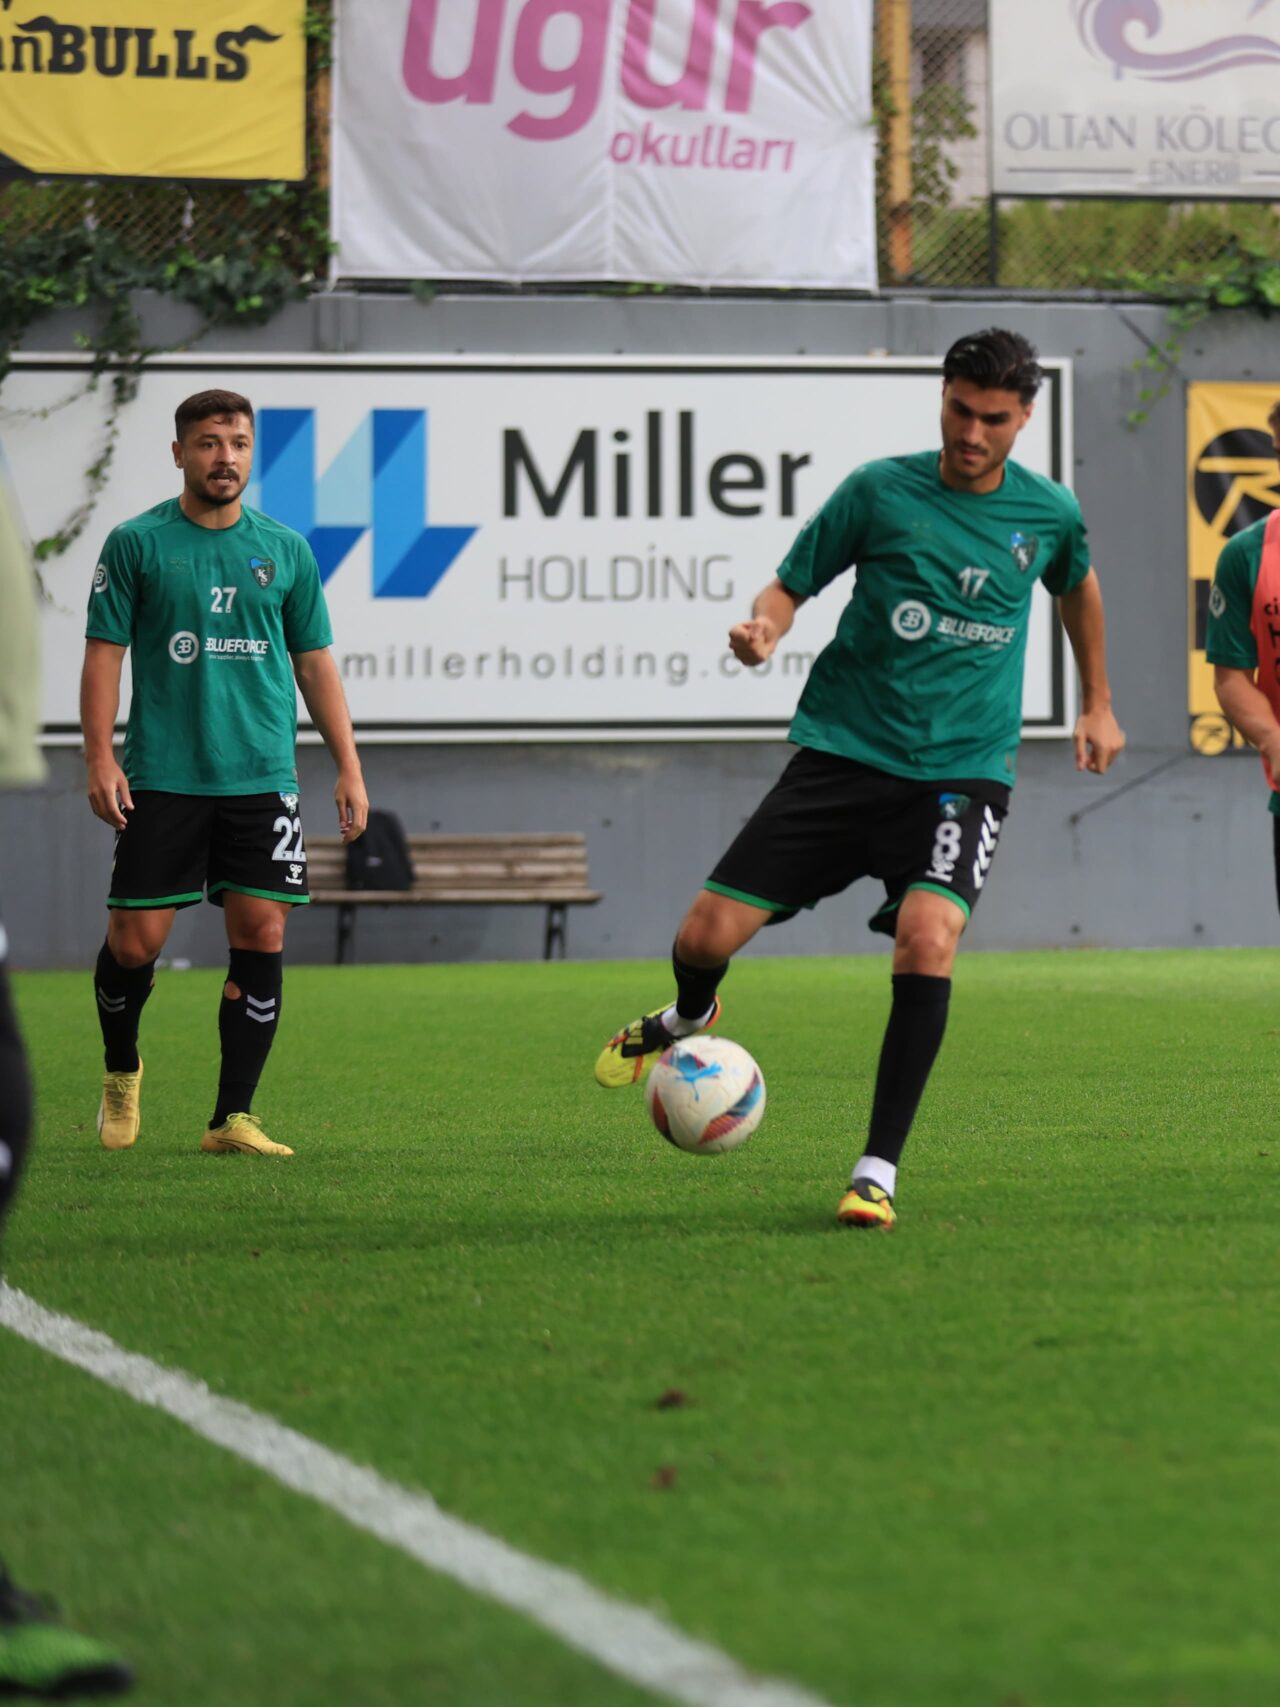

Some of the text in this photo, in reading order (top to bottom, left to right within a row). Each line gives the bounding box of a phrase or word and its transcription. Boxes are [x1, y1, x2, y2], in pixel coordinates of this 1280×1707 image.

[0, 16, 283, 82] nBULLS
[610, 123, 795, 173] okulları
[1004, 112, 1137, 151] OLTAN
[502, 409, 811, 518] Miller
[210, 586, 237, 613] 27
[958, 566, 990, 599] 17
[272, 815, 307, 862] 22
[932, 820, 962, 862] 8
